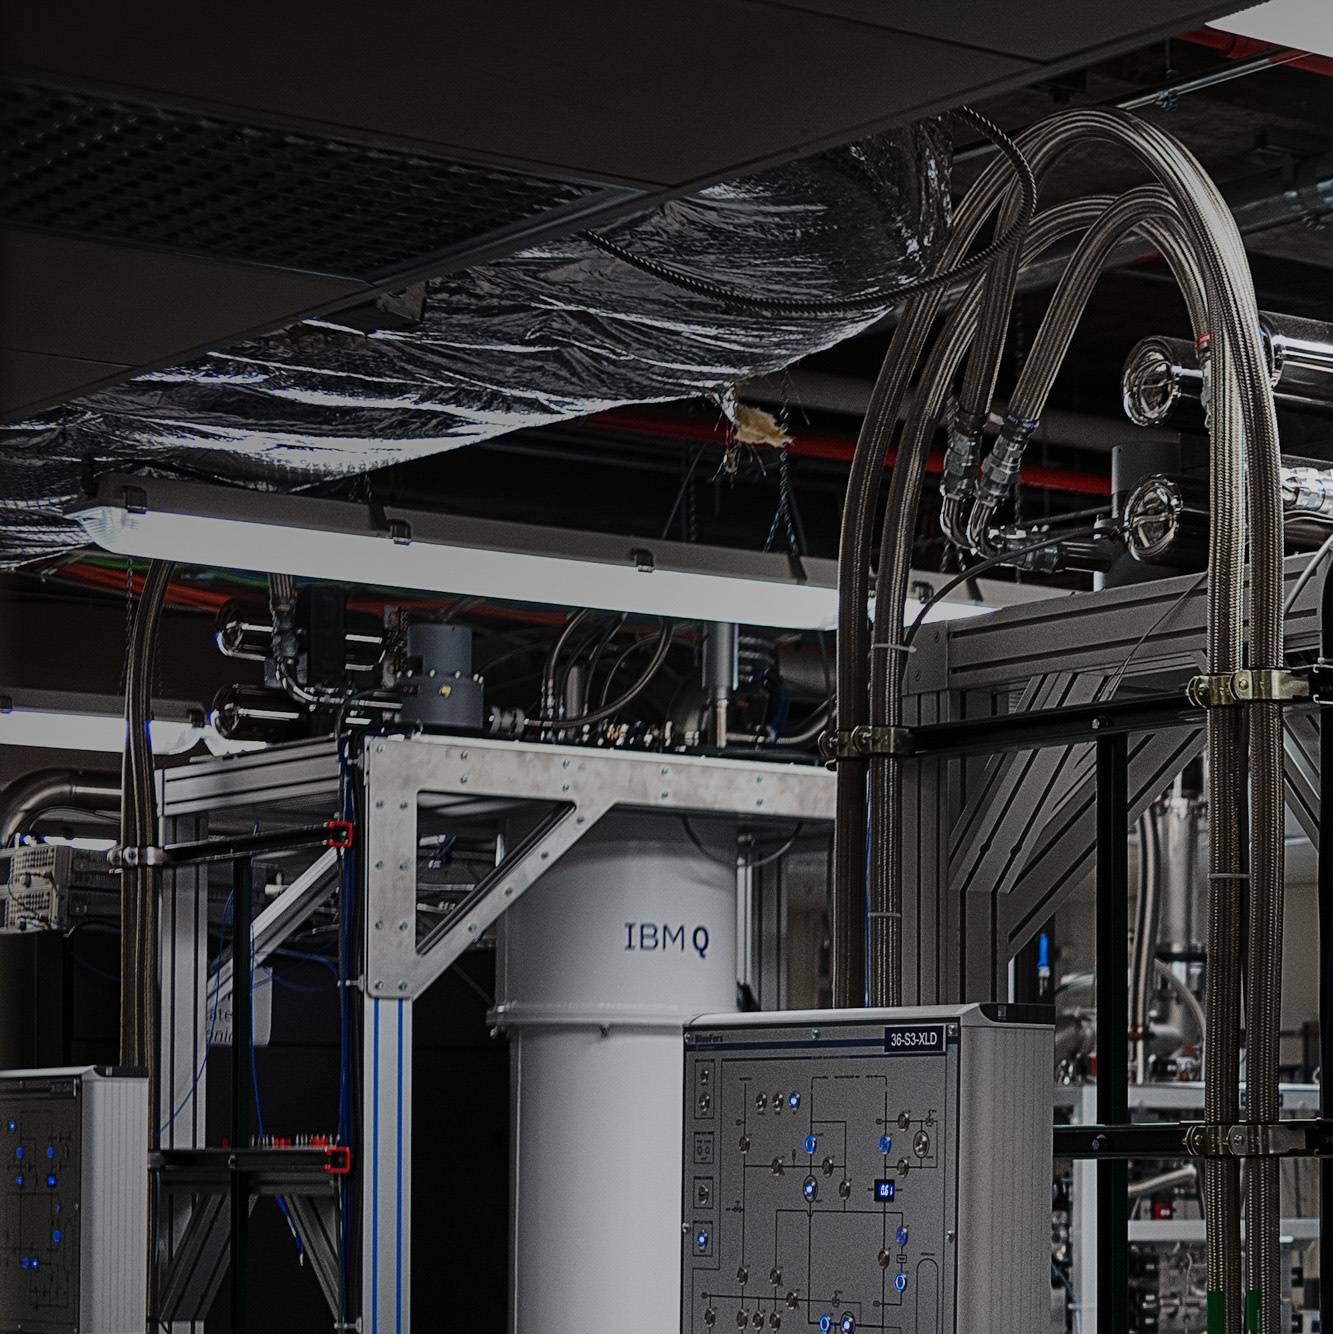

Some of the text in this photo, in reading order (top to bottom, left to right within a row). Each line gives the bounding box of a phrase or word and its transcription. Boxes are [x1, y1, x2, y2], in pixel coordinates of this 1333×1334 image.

[624, 922, 709, 959] IBM Q
[890, 1032, 938, 1046] 36-S3-XLD
